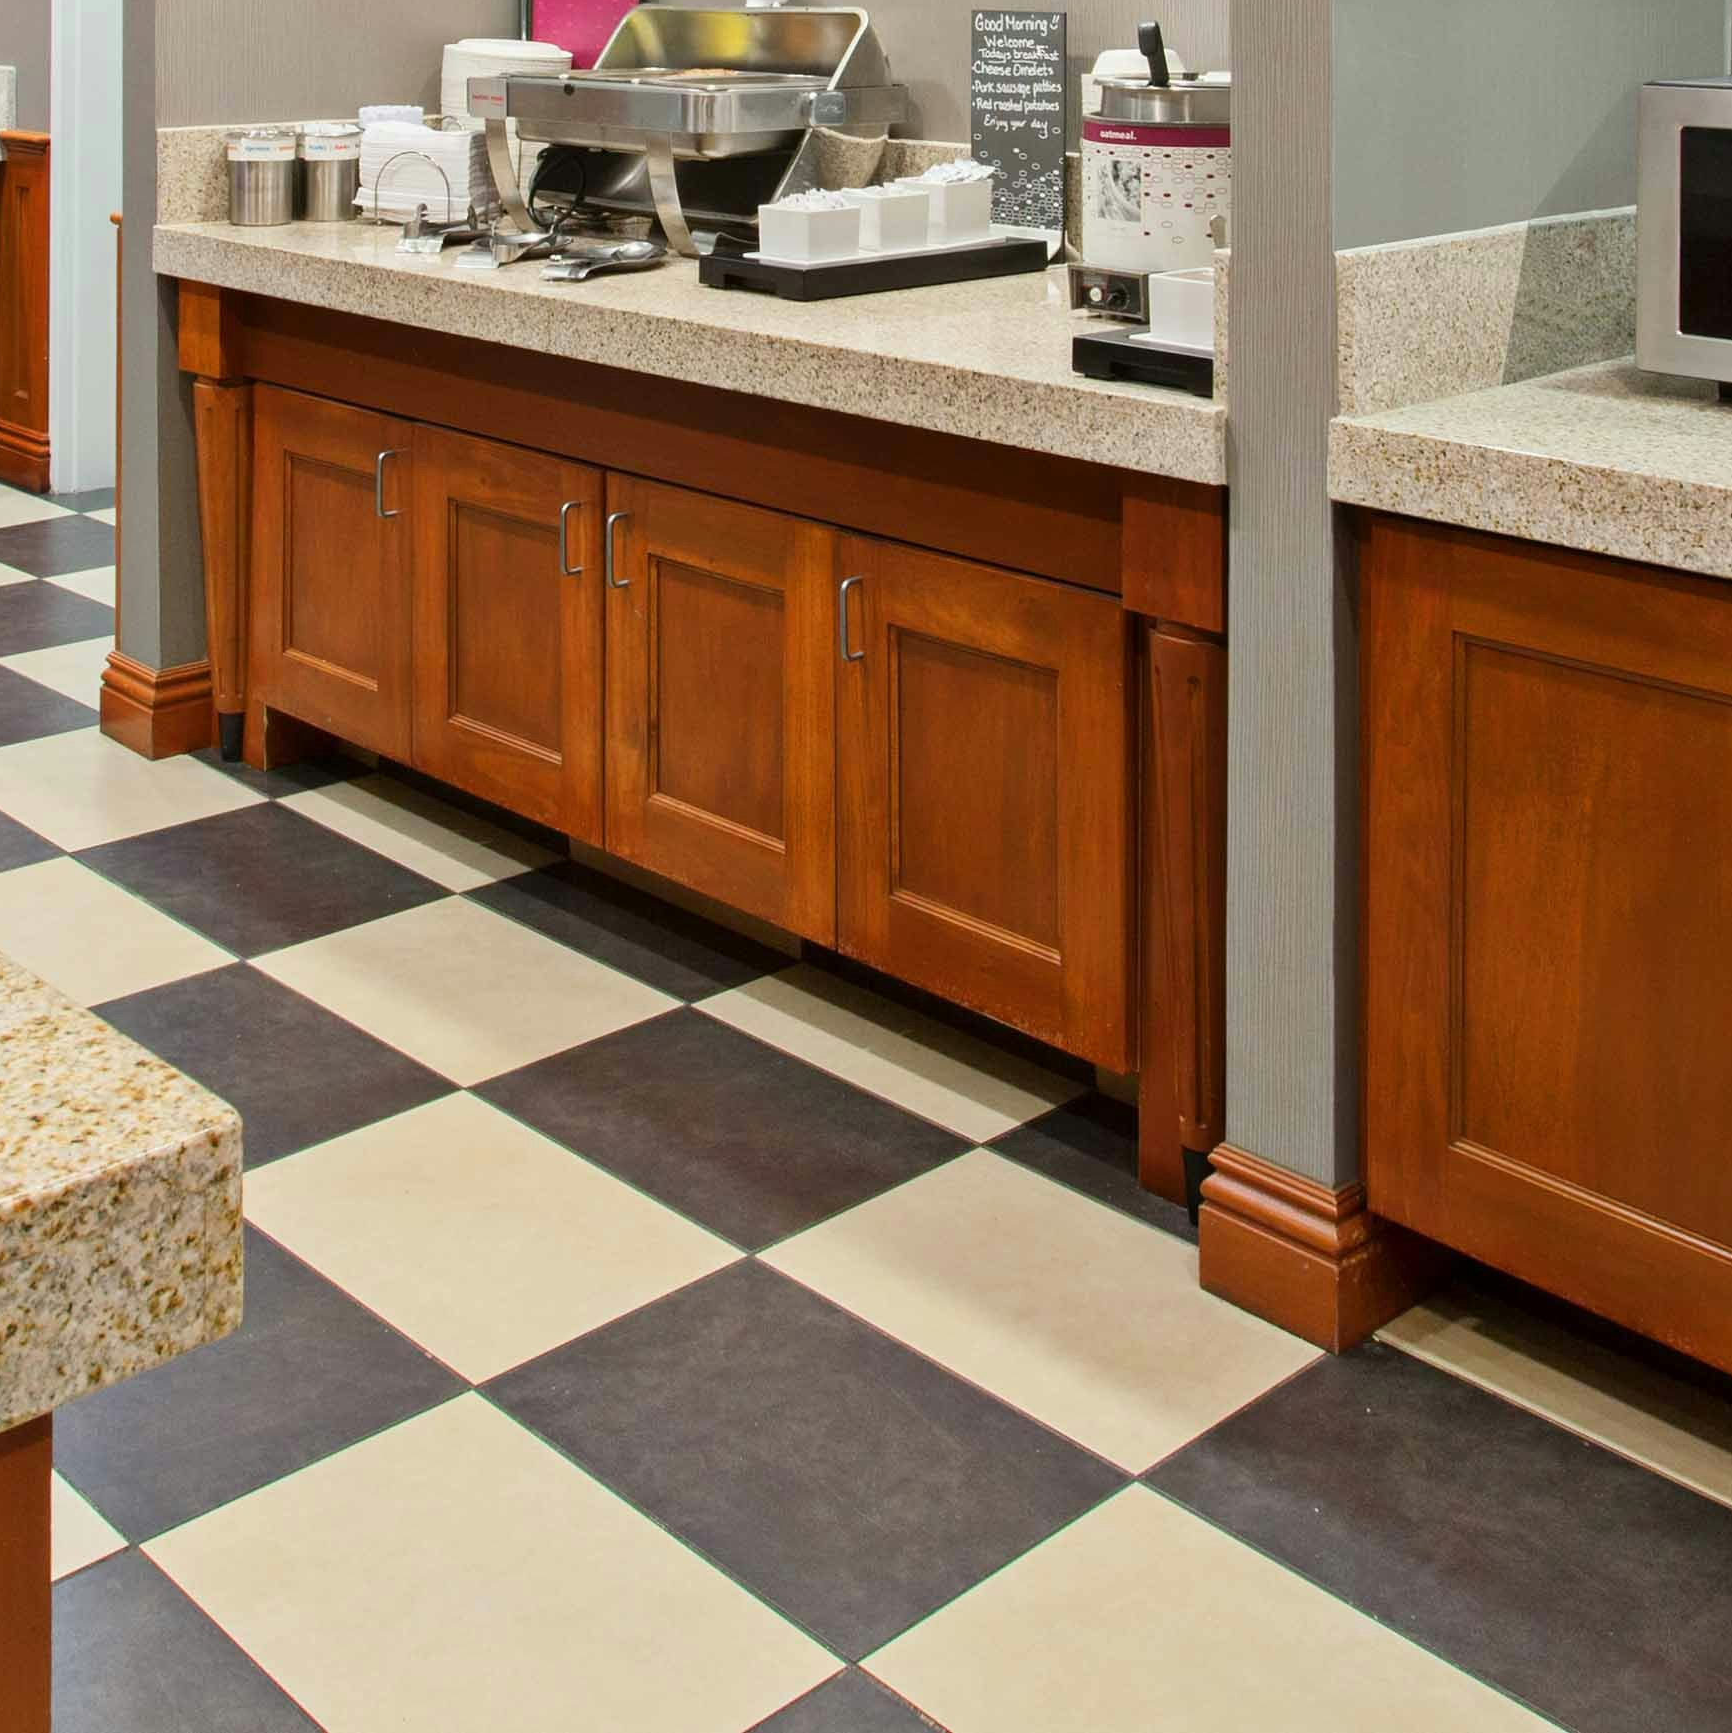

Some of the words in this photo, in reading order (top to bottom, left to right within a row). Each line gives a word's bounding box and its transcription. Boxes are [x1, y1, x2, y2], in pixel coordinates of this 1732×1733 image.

[975, 13, 1003, 31] Good
[1005, 14, 1047, 36] Morning
[973, 60, 1011, 76] Cheese
[1013, 62, 1054, 76] Omelets
[996, 83, 1031, 98] sausage
[1033, 79, 1062, 97] patties
[994, 98, 1022, 111] roasted
[1024, 99, 1060, 115] potatoes
[984, 114, 1008, 132] Enjoy
[1030, 118, 1048, 139] day
